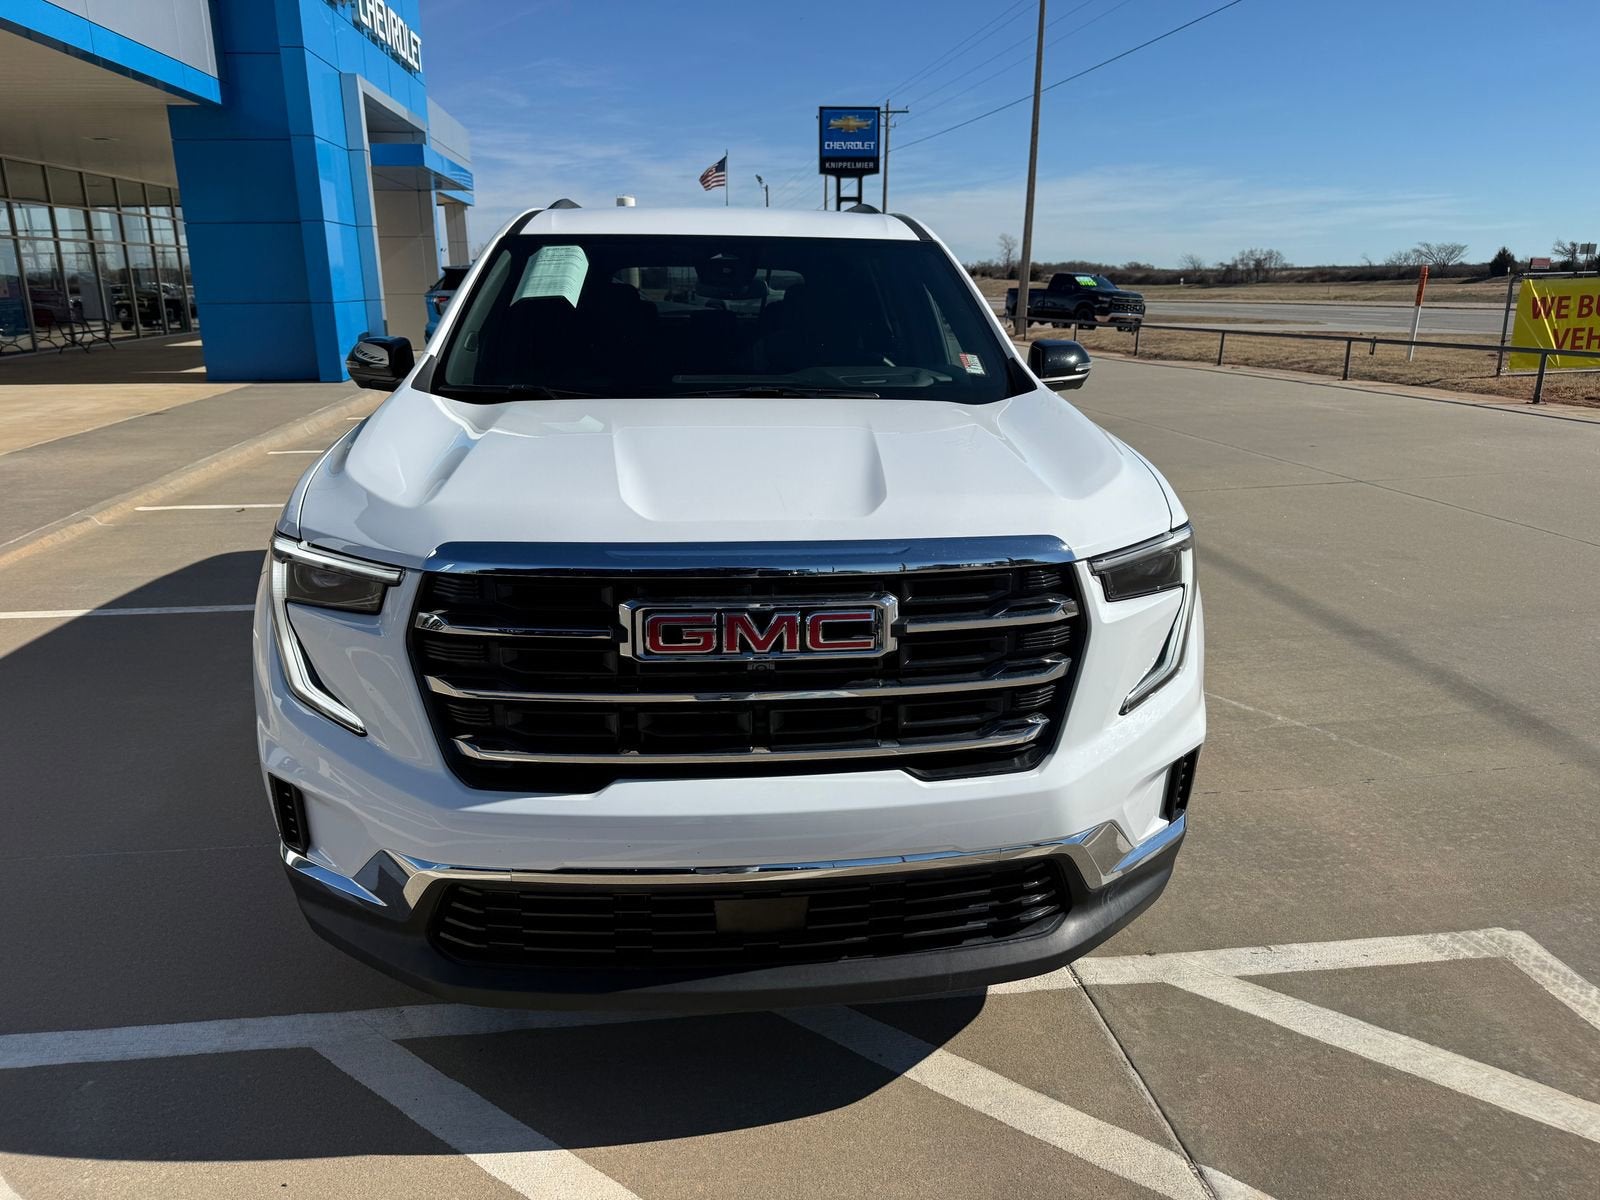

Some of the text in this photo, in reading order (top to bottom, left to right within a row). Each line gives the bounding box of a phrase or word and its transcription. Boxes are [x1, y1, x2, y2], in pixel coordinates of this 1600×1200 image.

[358, 0, 422, 73] CHEVROLET
[824, 141, 875, 150] CHEVROLET
[825, 161, 874, 169] KNIPPELMIER
[1531, 295, 1571, 320] WE
[646, 611, 875, 653] GMC
